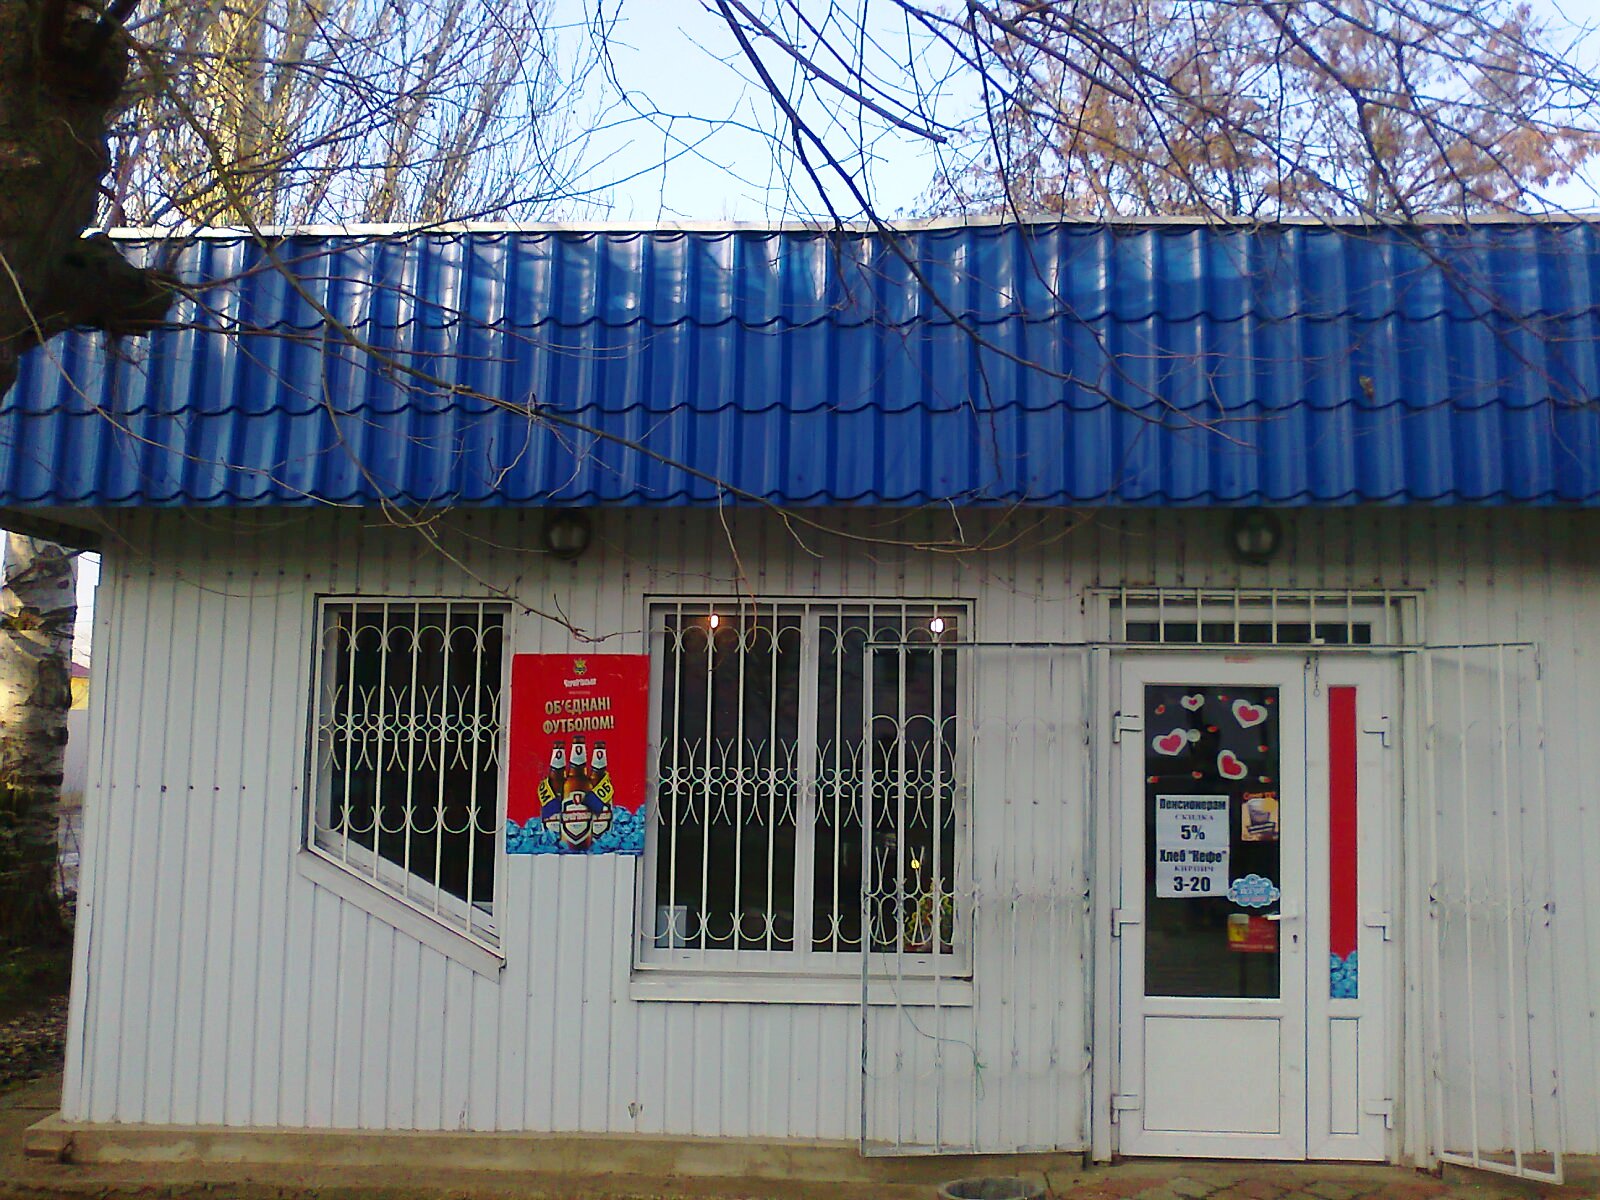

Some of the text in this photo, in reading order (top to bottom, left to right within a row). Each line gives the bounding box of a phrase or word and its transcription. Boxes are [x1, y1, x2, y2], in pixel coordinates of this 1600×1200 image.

[542, 715, 615, 734] ФУТБОЛОМ!
[1181, 824, 1206, 840] 5%
[1159, 849, 1186, 863] Хлеб
[1173, 876, 1211, 892] 3-20
